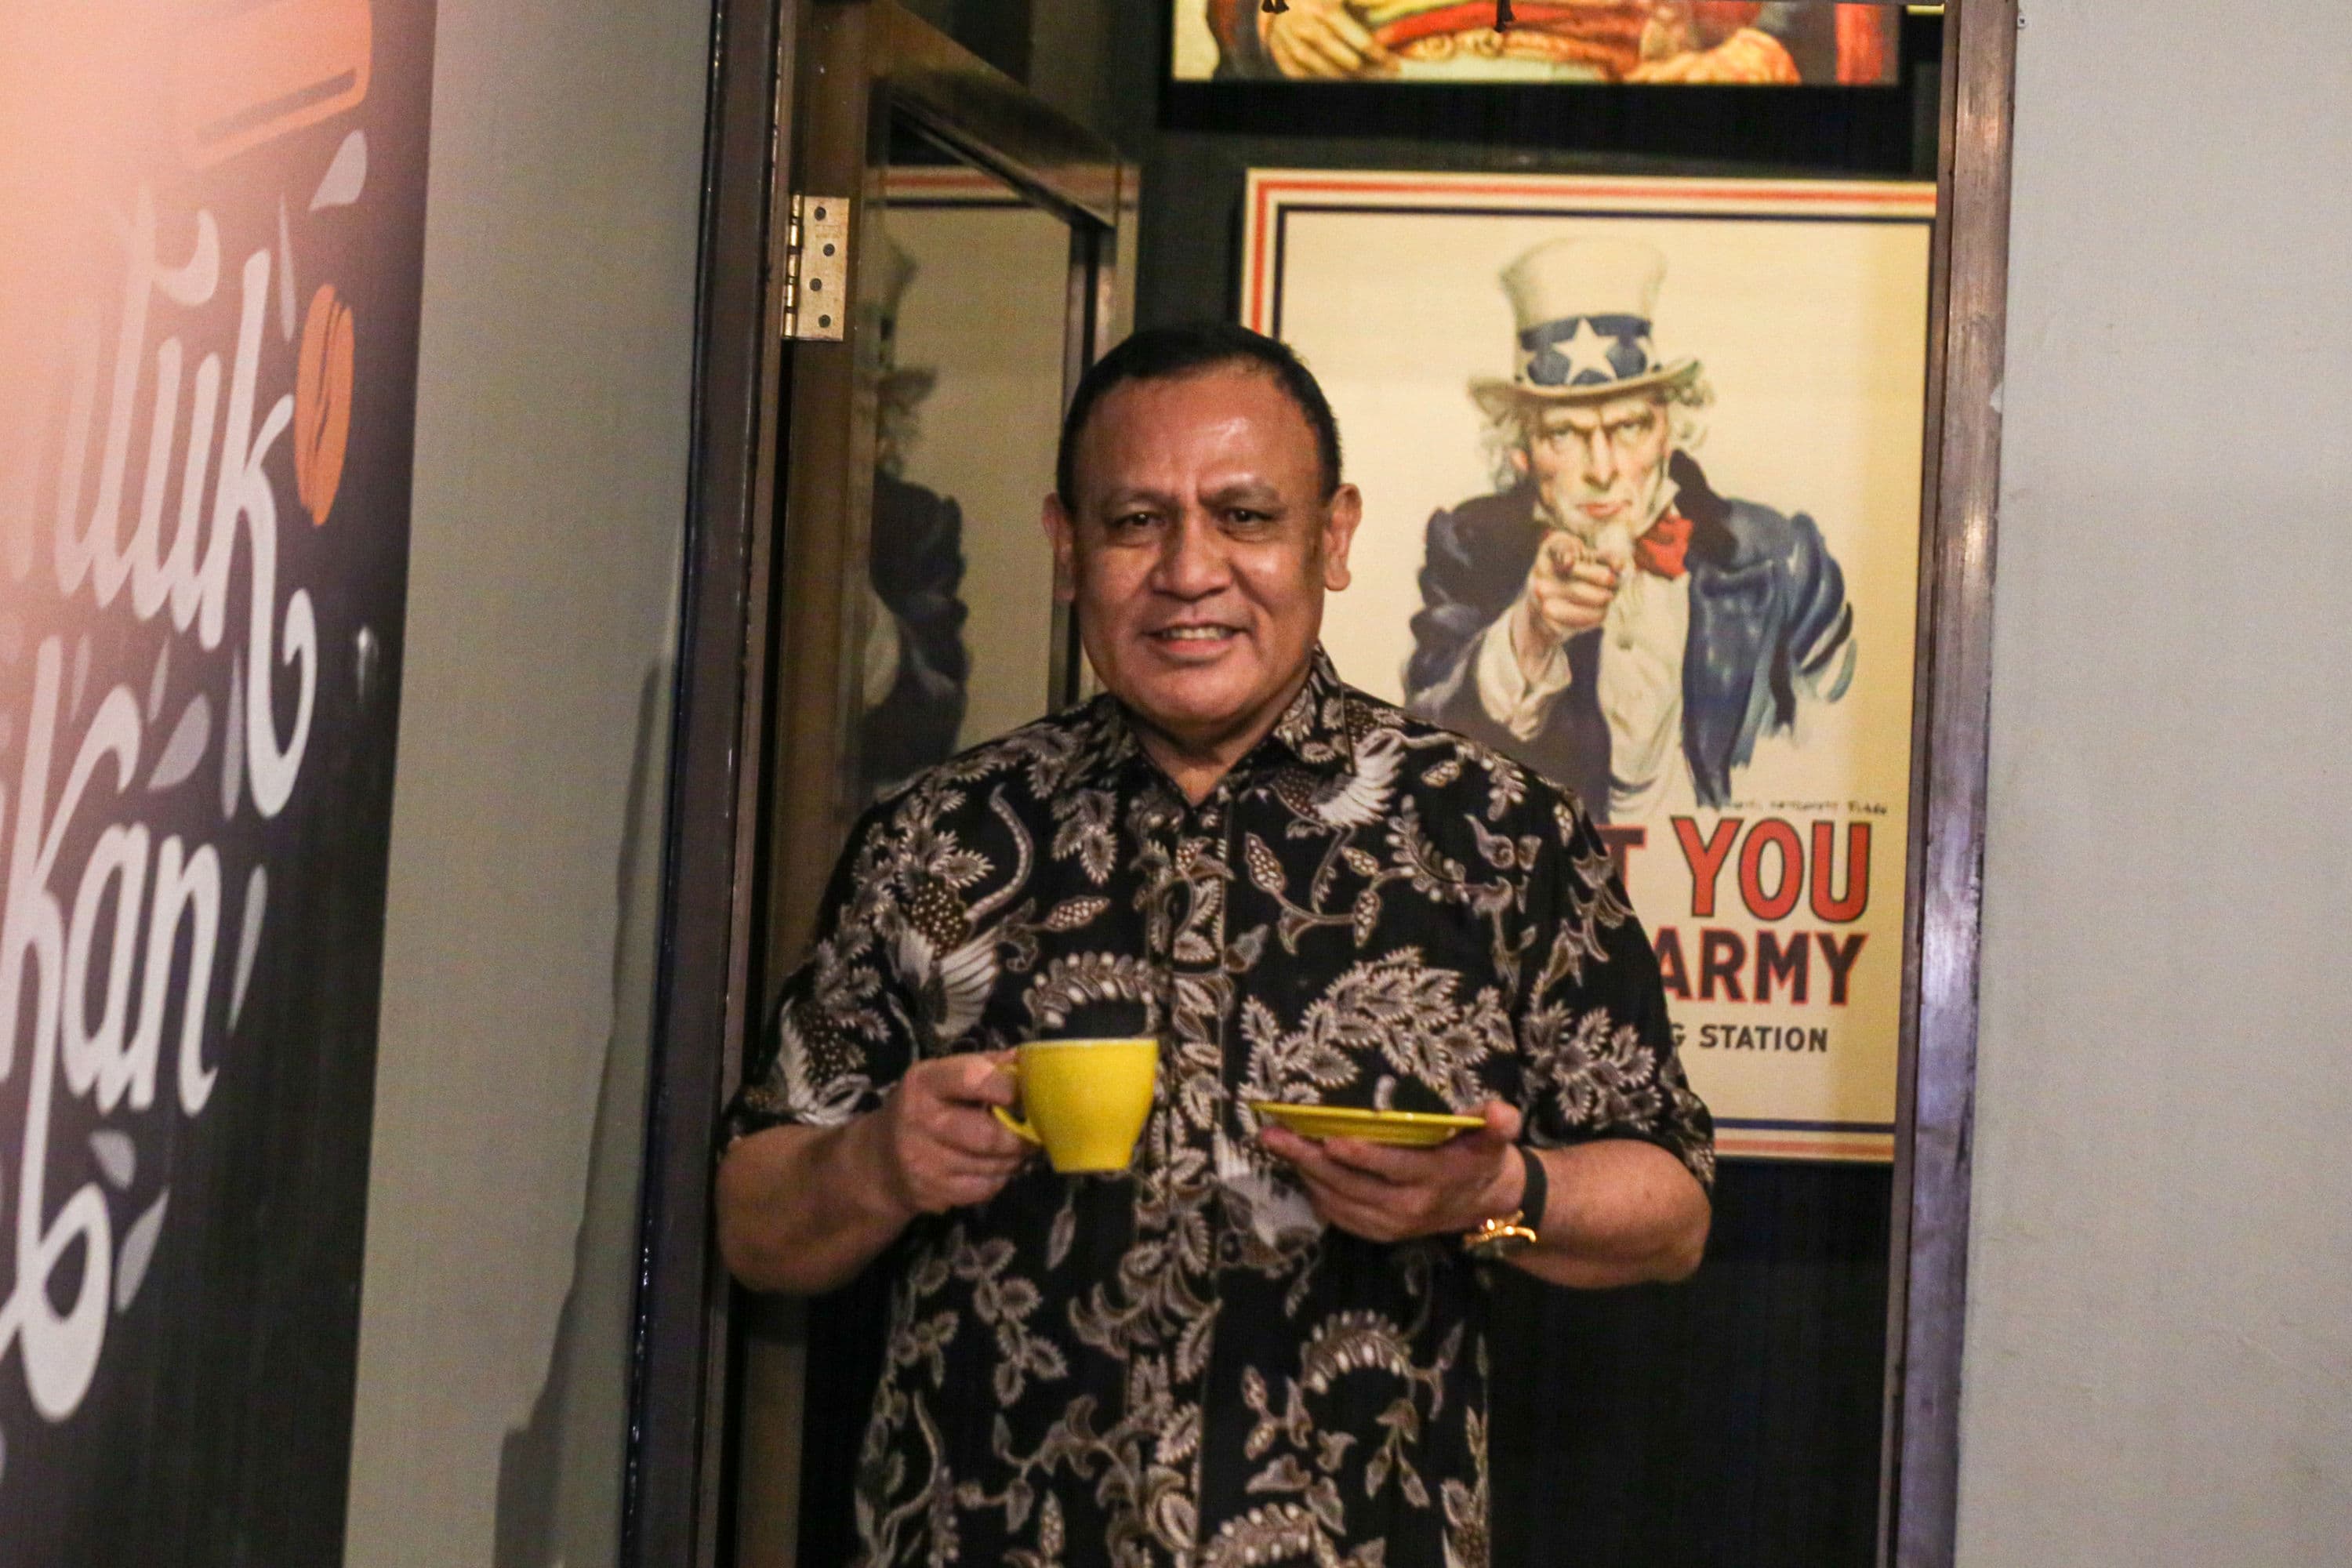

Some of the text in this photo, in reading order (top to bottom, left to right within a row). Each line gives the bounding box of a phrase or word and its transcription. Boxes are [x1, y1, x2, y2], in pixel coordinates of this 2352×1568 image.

[1669, 815, 1872, 924] YOU
[1651, 926, 1870, 1007] ARMY
[1699, 1022, 1828, 1052] STATION
